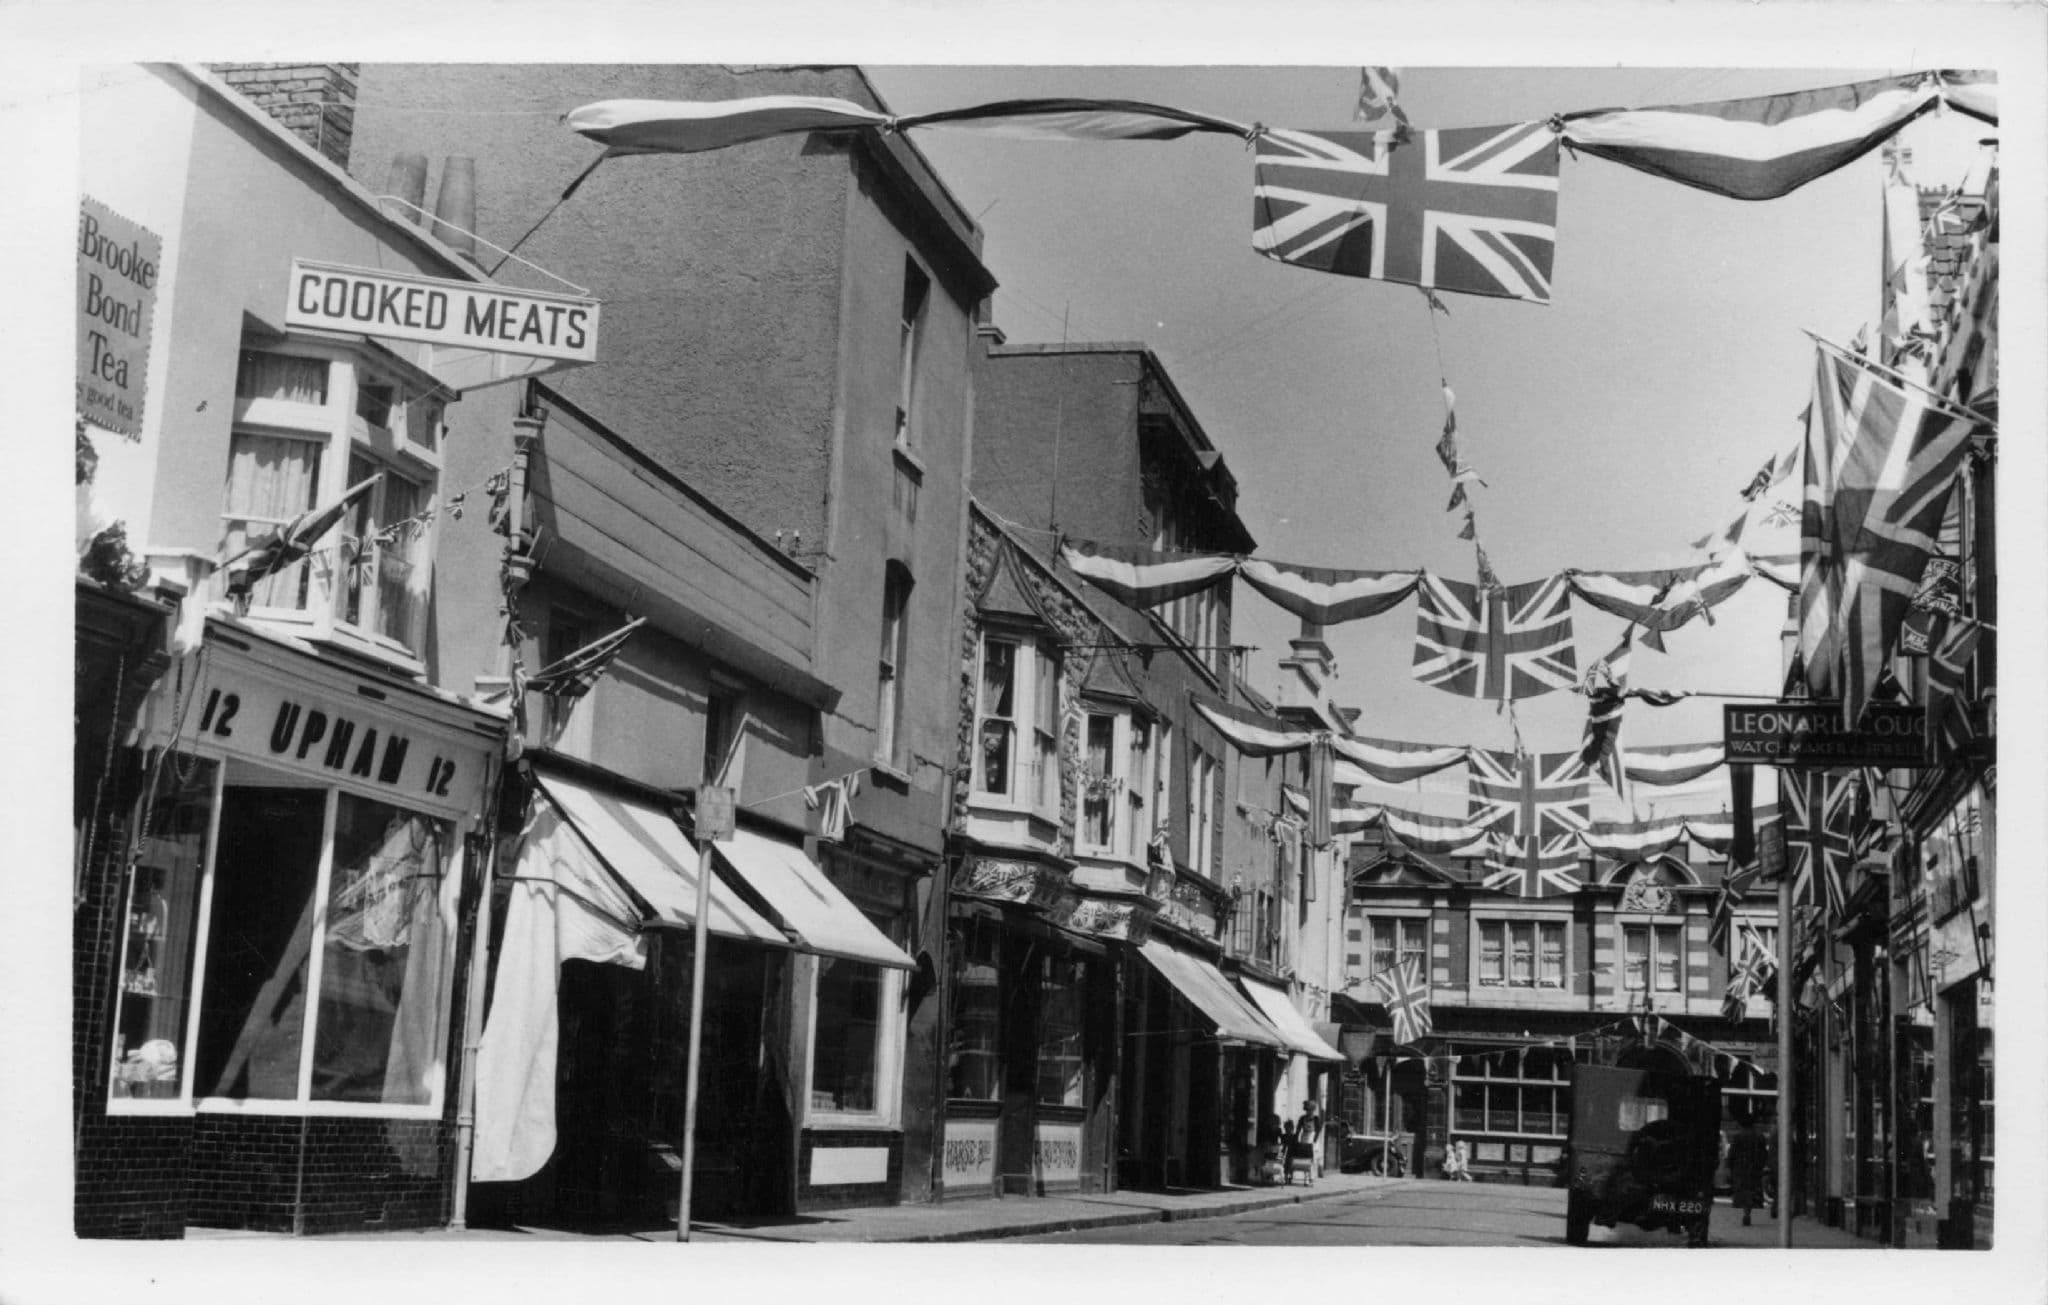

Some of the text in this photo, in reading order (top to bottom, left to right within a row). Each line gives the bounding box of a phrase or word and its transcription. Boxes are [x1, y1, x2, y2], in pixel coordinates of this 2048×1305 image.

[81, 215, 155, 290] Brooke
[85, 272, 142, 339] Bond
[298, 273, 588, 350] COOKED MEATS
[87, 329, 129, 390] Tea
[201, 687, 241, 737] 12
[426, 754, 456, 797] 12
[1653, 1199, 1703, 1214] NHX 220
